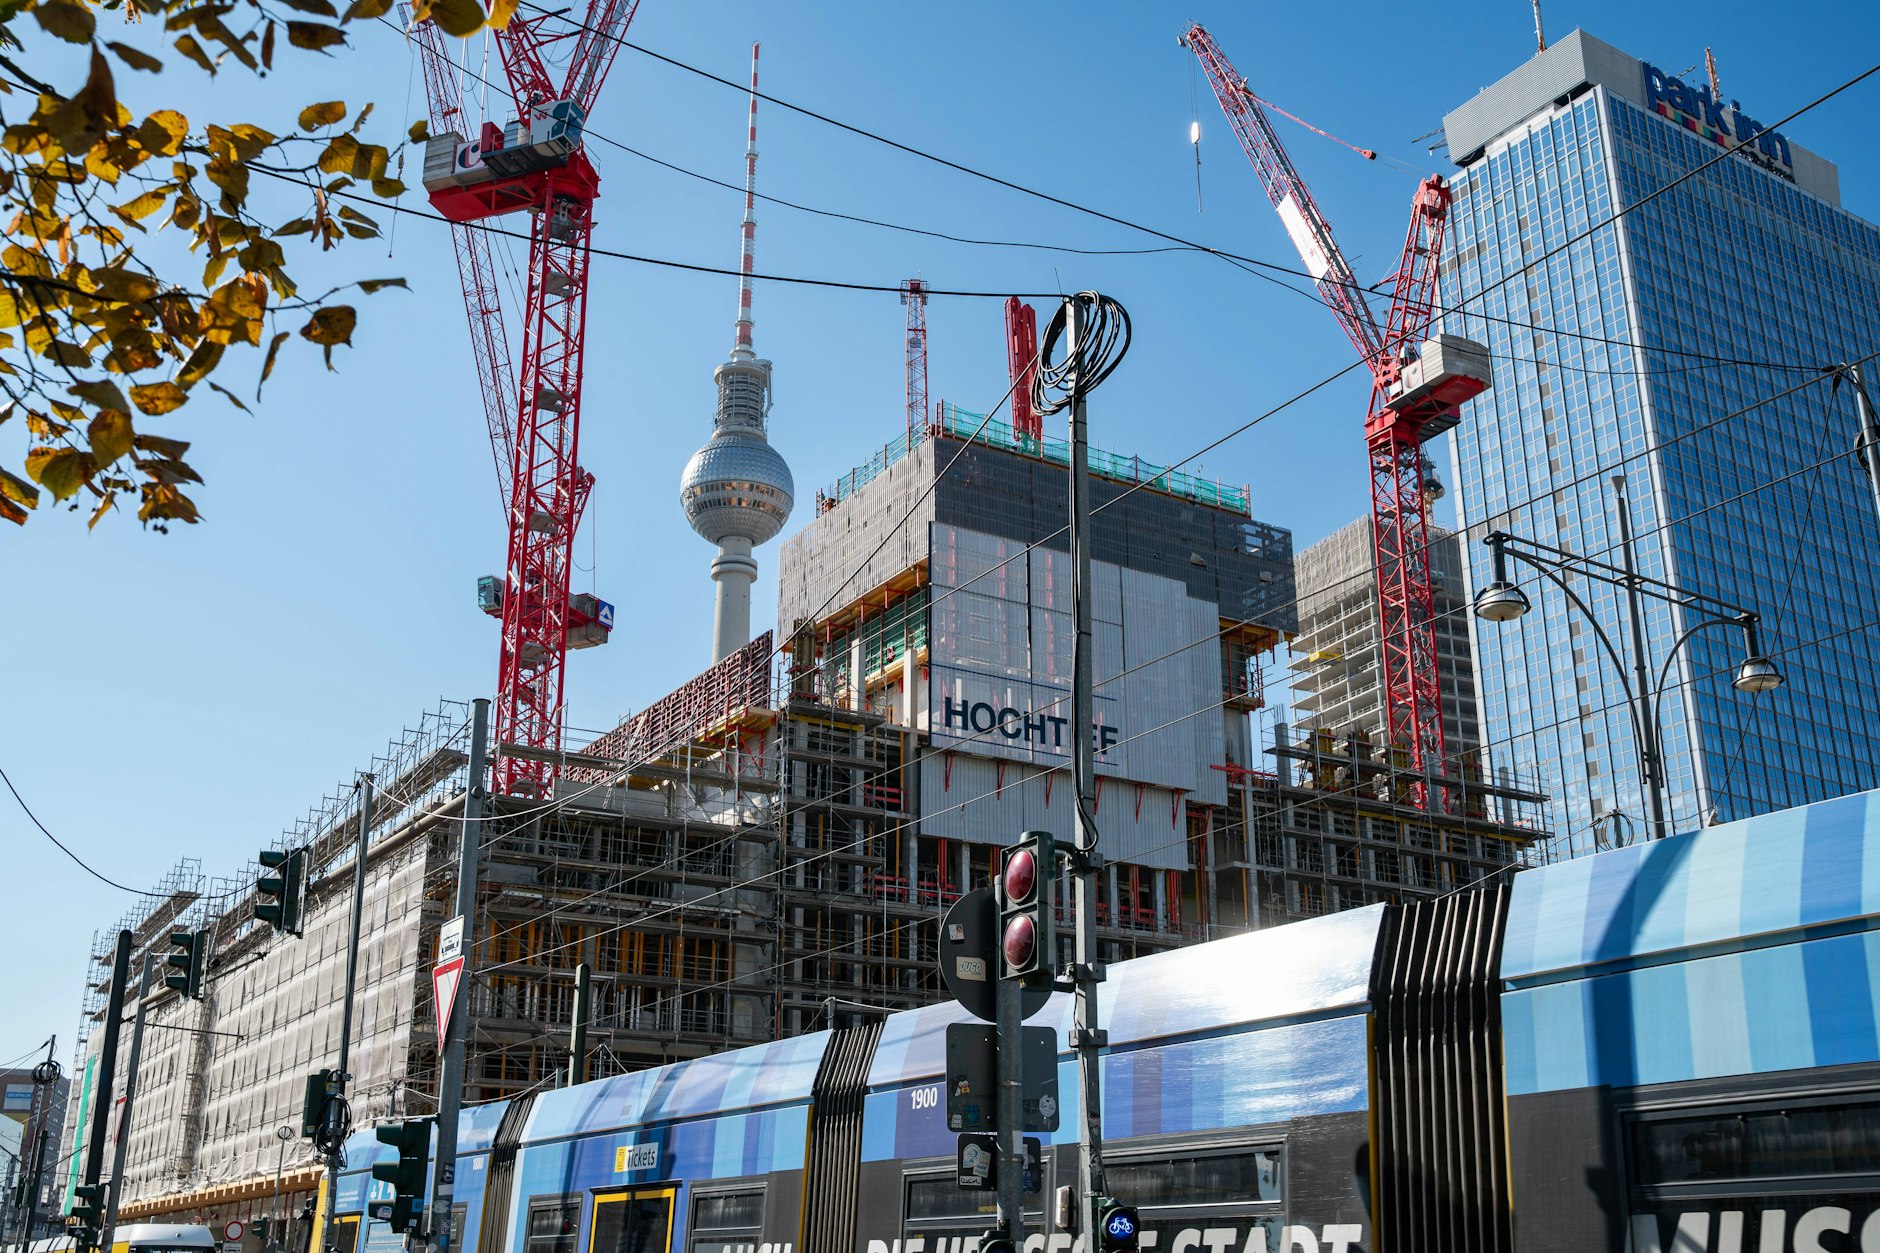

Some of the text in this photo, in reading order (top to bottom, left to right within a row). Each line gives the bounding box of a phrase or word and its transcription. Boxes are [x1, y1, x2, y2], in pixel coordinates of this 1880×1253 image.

[1642, 61, 1732, 136] park
[1730, 98, 1793, 168] inn
[945, 696, 1119, 755] HOCHTF
[911, 1086, 938, 1110] 1900
[627, 1146, 656, 1168] Tickets
